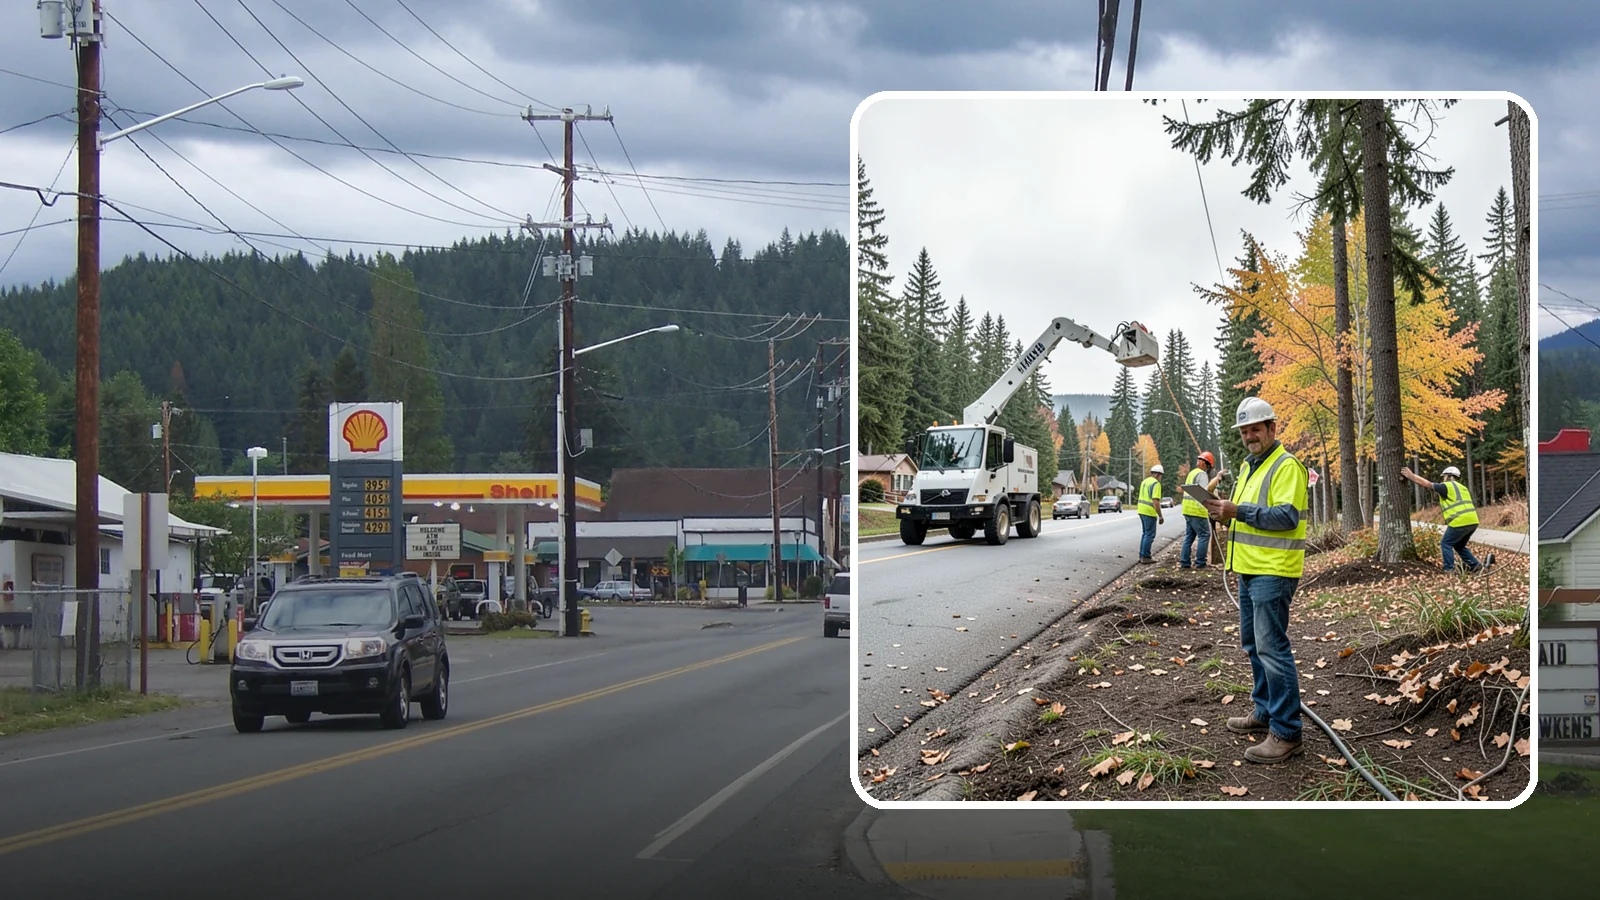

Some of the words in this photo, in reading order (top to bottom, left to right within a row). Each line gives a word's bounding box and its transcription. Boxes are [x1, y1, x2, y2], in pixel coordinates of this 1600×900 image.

[490, 484, 547, 499] Shell
[365, 494, 383, 504] 405
[365, 508, 383, 518] 415
[365, 522, 383, 532] 429
